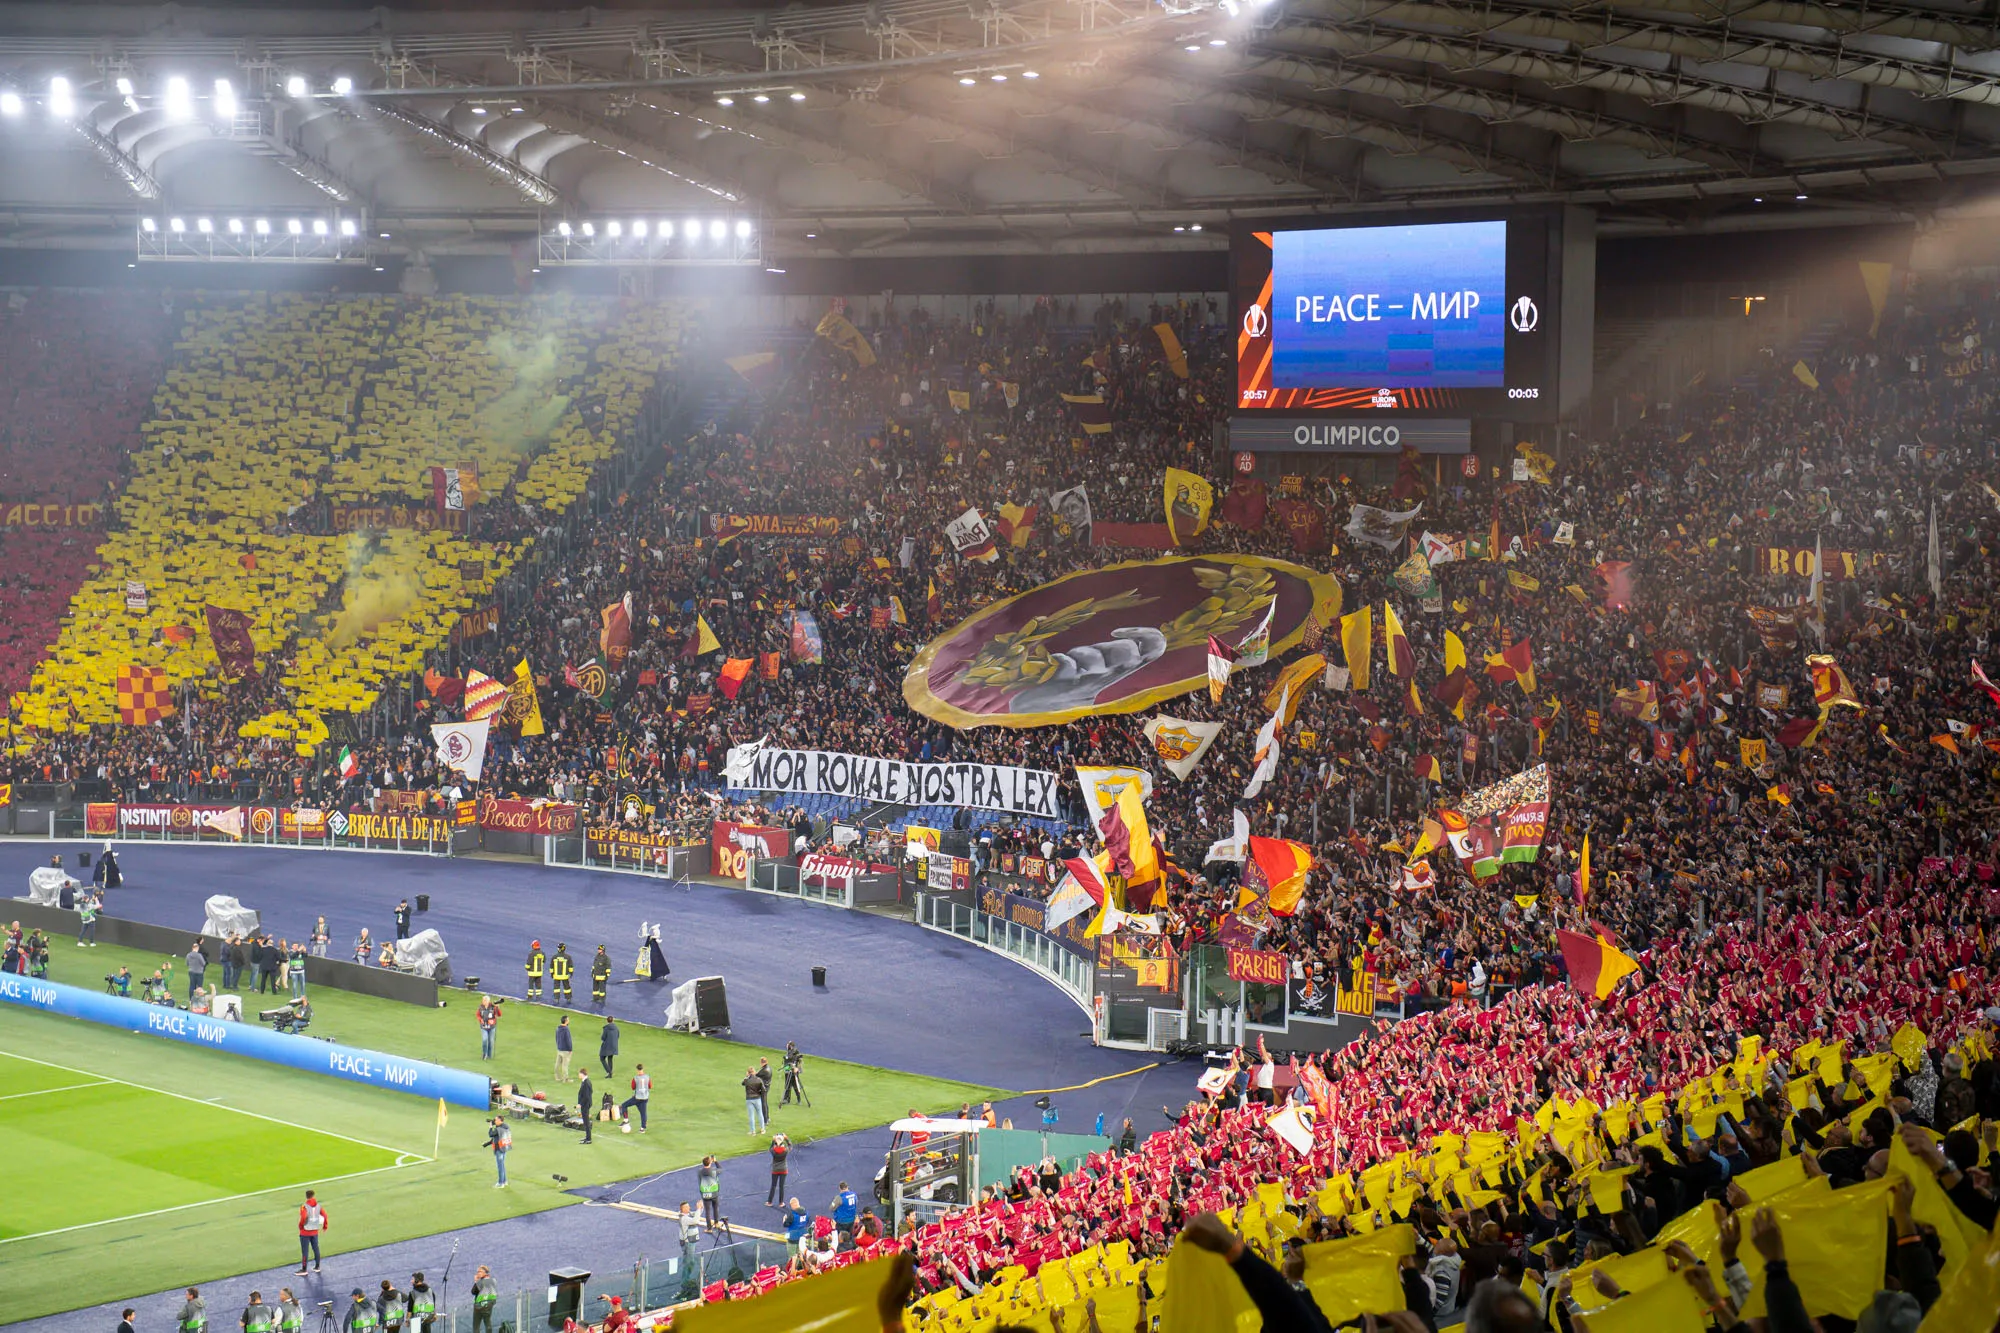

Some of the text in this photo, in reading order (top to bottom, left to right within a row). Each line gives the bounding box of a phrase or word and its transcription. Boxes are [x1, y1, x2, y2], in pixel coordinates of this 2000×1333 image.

[1295, 294, 1381, 323] PEACE
[1411, 291, 1480, 321] МИР
[1243, 390, 1267, 400] 20:57
[1508, 388, 1539, 399] 00:03
[1294, 425, 1400, 446] OLIMPICO
[0, 503, 95, 526] ACCIO
[333, 508, 386, 530] GATE
[733, 751, 1054, 815] MOR ROMAE NOSTRA LEX
[120, 808, 170, 825] DISTINTI
[192, 810, 244, 828] ROI
[348, 813, 408, 839] BRIGATA
[412, 817, 429, 840] DE
[432, 819, 455, 842] FA
[588, 827, 675, 846] OFFENSIVA
[31, 986, 57, 1005] МИР
[1337, 988, 1374, 1014] MOU
[149, 1012, 186, 1035] PEACE
[197, 1023, 226, 1044] МИР
[330, 1052, 371, 1077] PEACE
[385, 1063, 418, 1086] МИР
